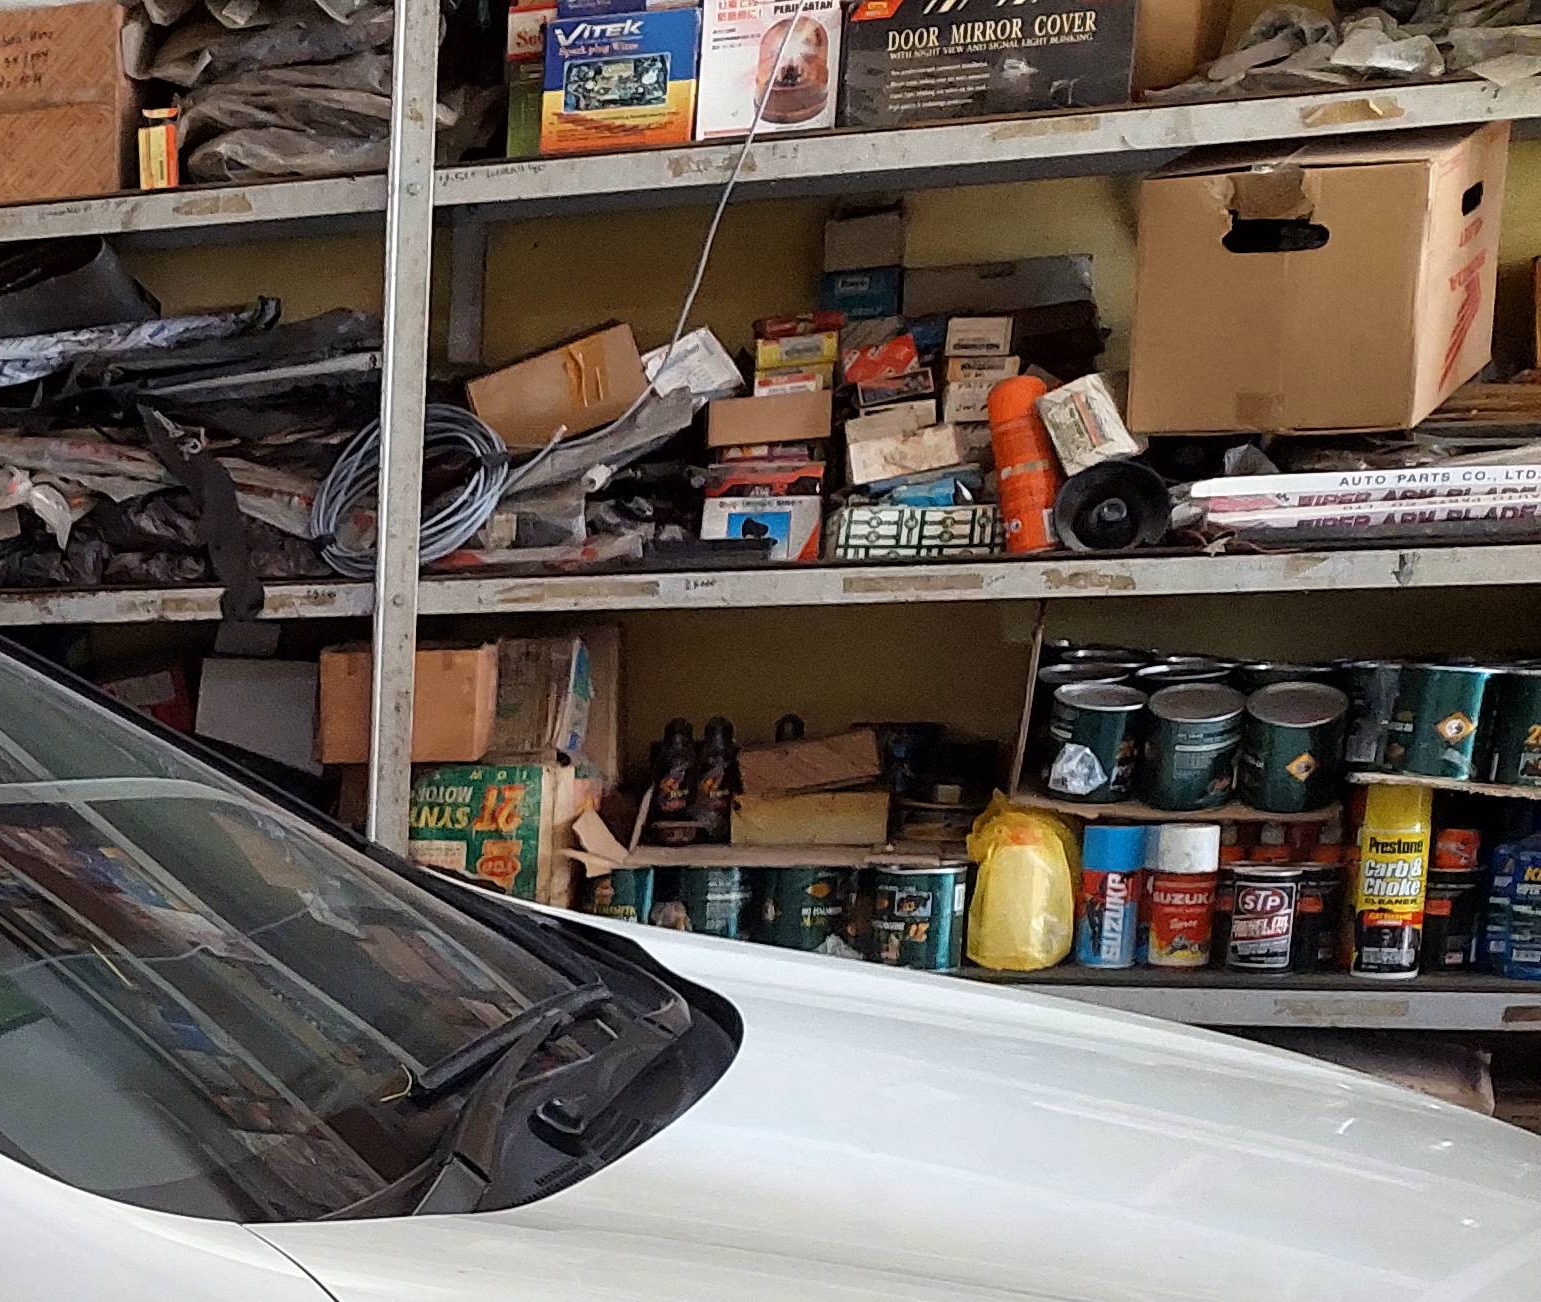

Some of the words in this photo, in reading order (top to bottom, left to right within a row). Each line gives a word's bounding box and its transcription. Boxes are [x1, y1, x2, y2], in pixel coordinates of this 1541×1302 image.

[554, 19, 645, 46] VITEK
[887, 26, 939, 51] DOOR
[950, 18, 1022, 45] MIRROR
[1034, 10, 1097, 36] COVER
[1339, 475, 1387, 488] AUTO
[1397, 471, 1451, 484] PARTS
[1369, 837, 1424, 855] Prestone
[1363, 877, 1422, 897] Choke
[1244, 890, 1281, 912] STP
